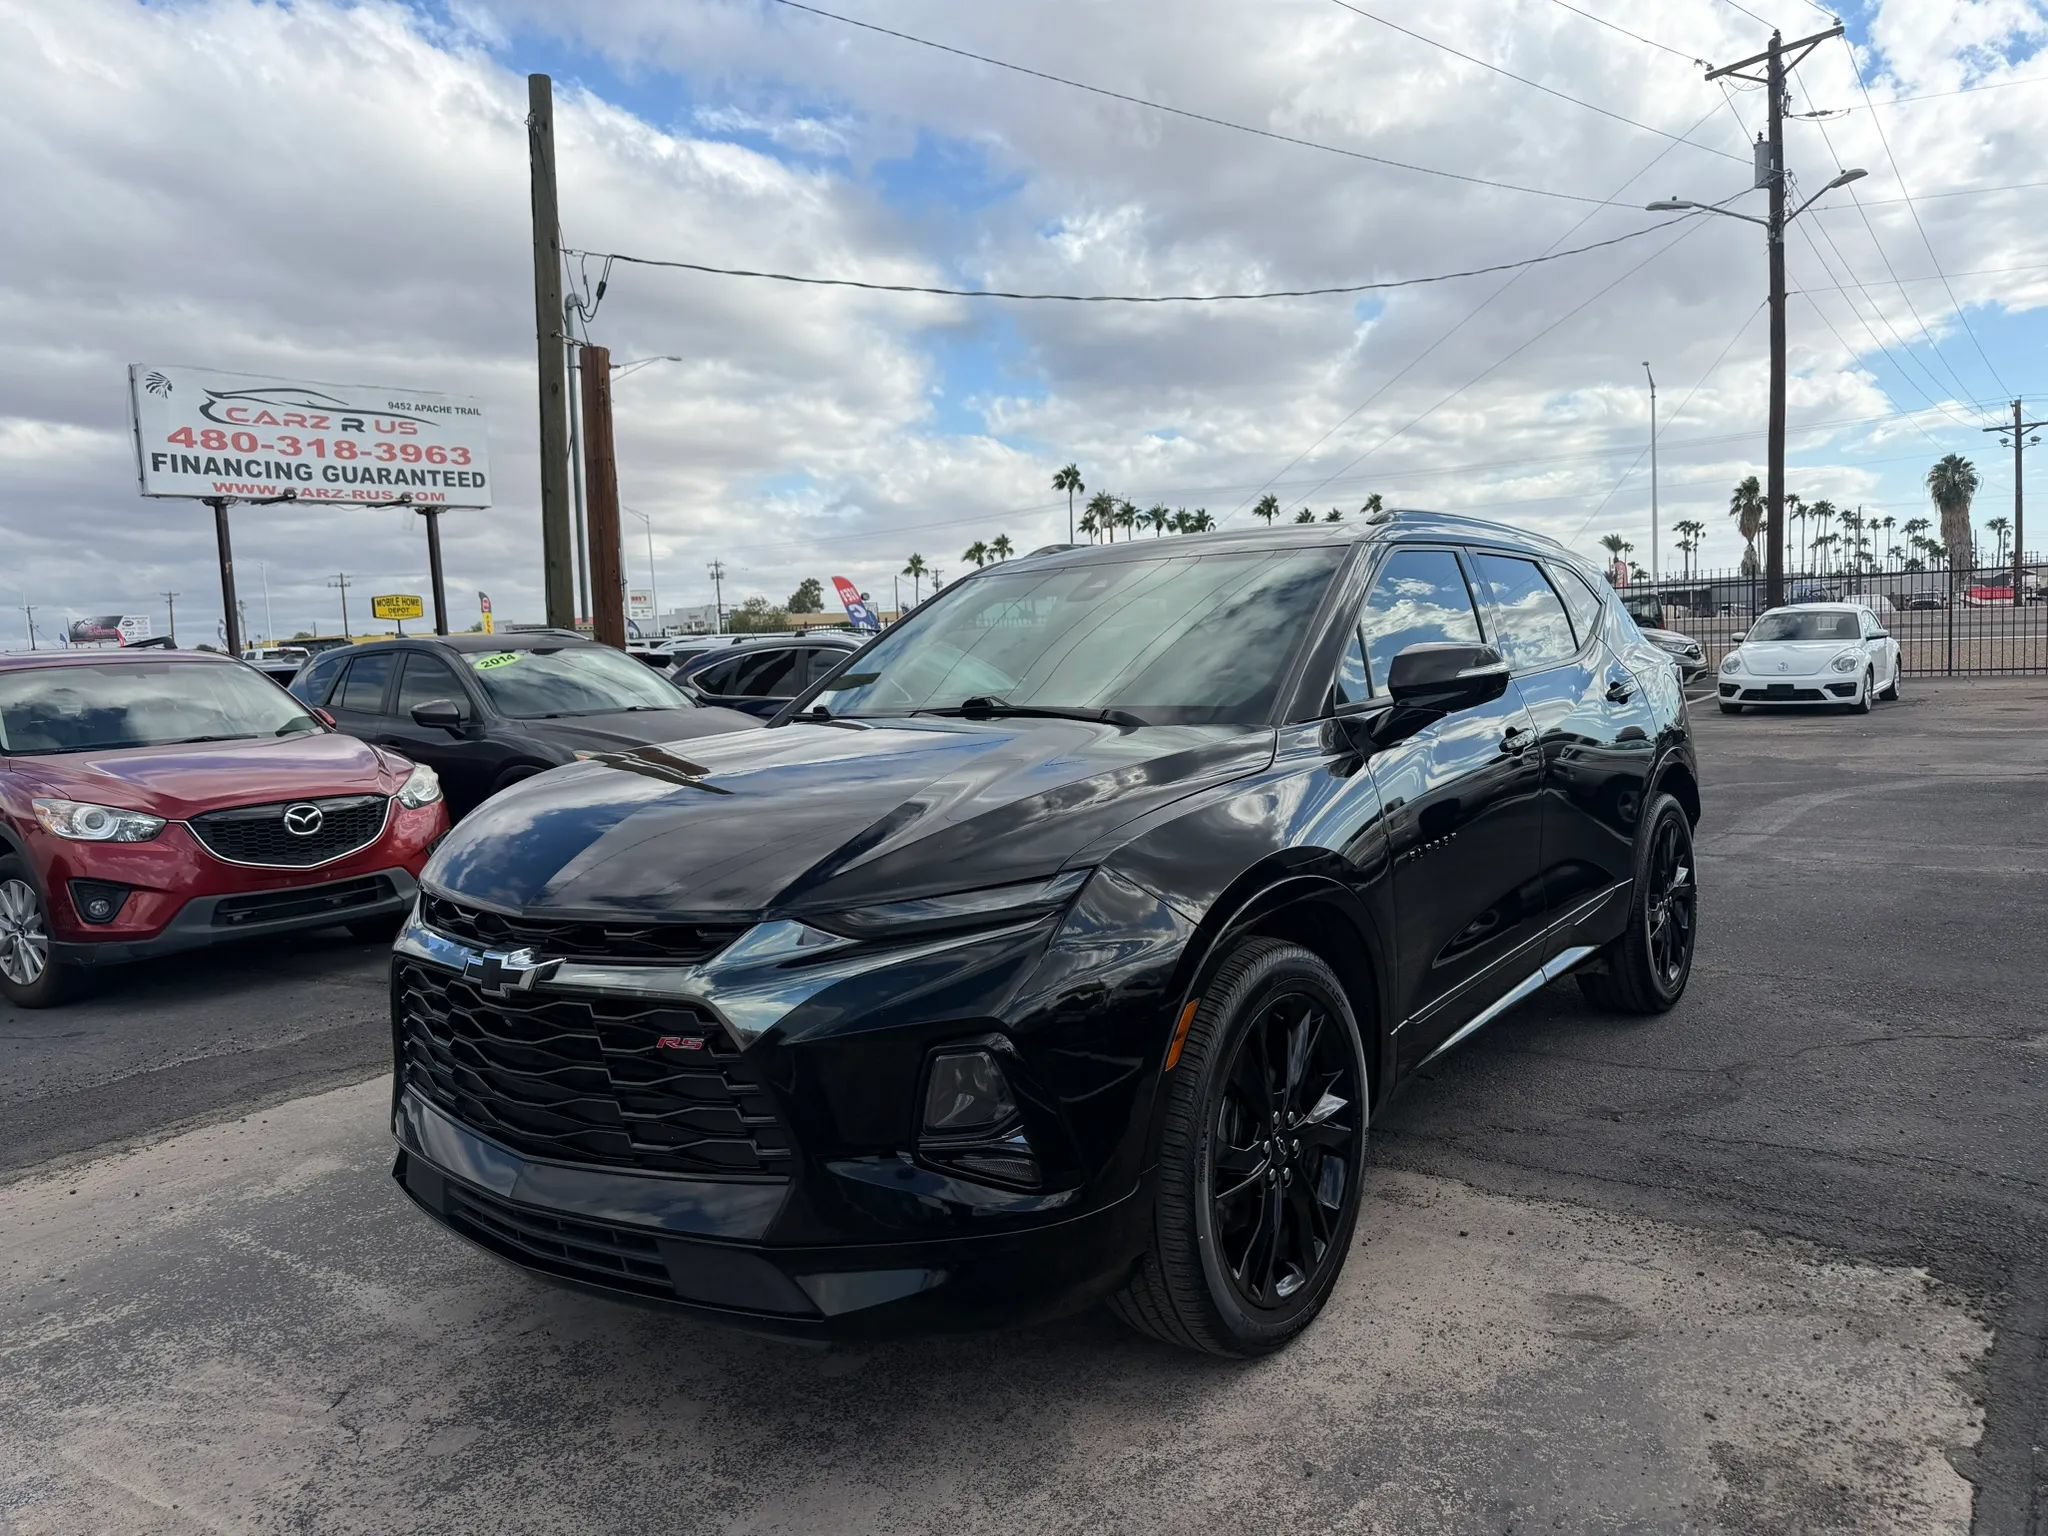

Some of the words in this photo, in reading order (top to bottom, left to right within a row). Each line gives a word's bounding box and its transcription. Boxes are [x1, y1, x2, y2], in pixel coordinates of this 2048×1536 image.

[388, 401, 412, 412] 9452
[414, 405, 453, 415] APACHE
[454, 407, 482, 416] TRAIL
[225, 407, 331, 430] CARZ
[341, 417, 366, 433] R
[374, 419, 418, 436] US
[167, 426, 472, 466] 480-318-3963
[151, 452, 313, 482] FINANCING
[322, 464, 486, 488] GUARANTEED
[376, 597, 400, 607] MOBILE
[481, 654, 516, 668] 2014
[656, 1036, 704, 1050] RS
